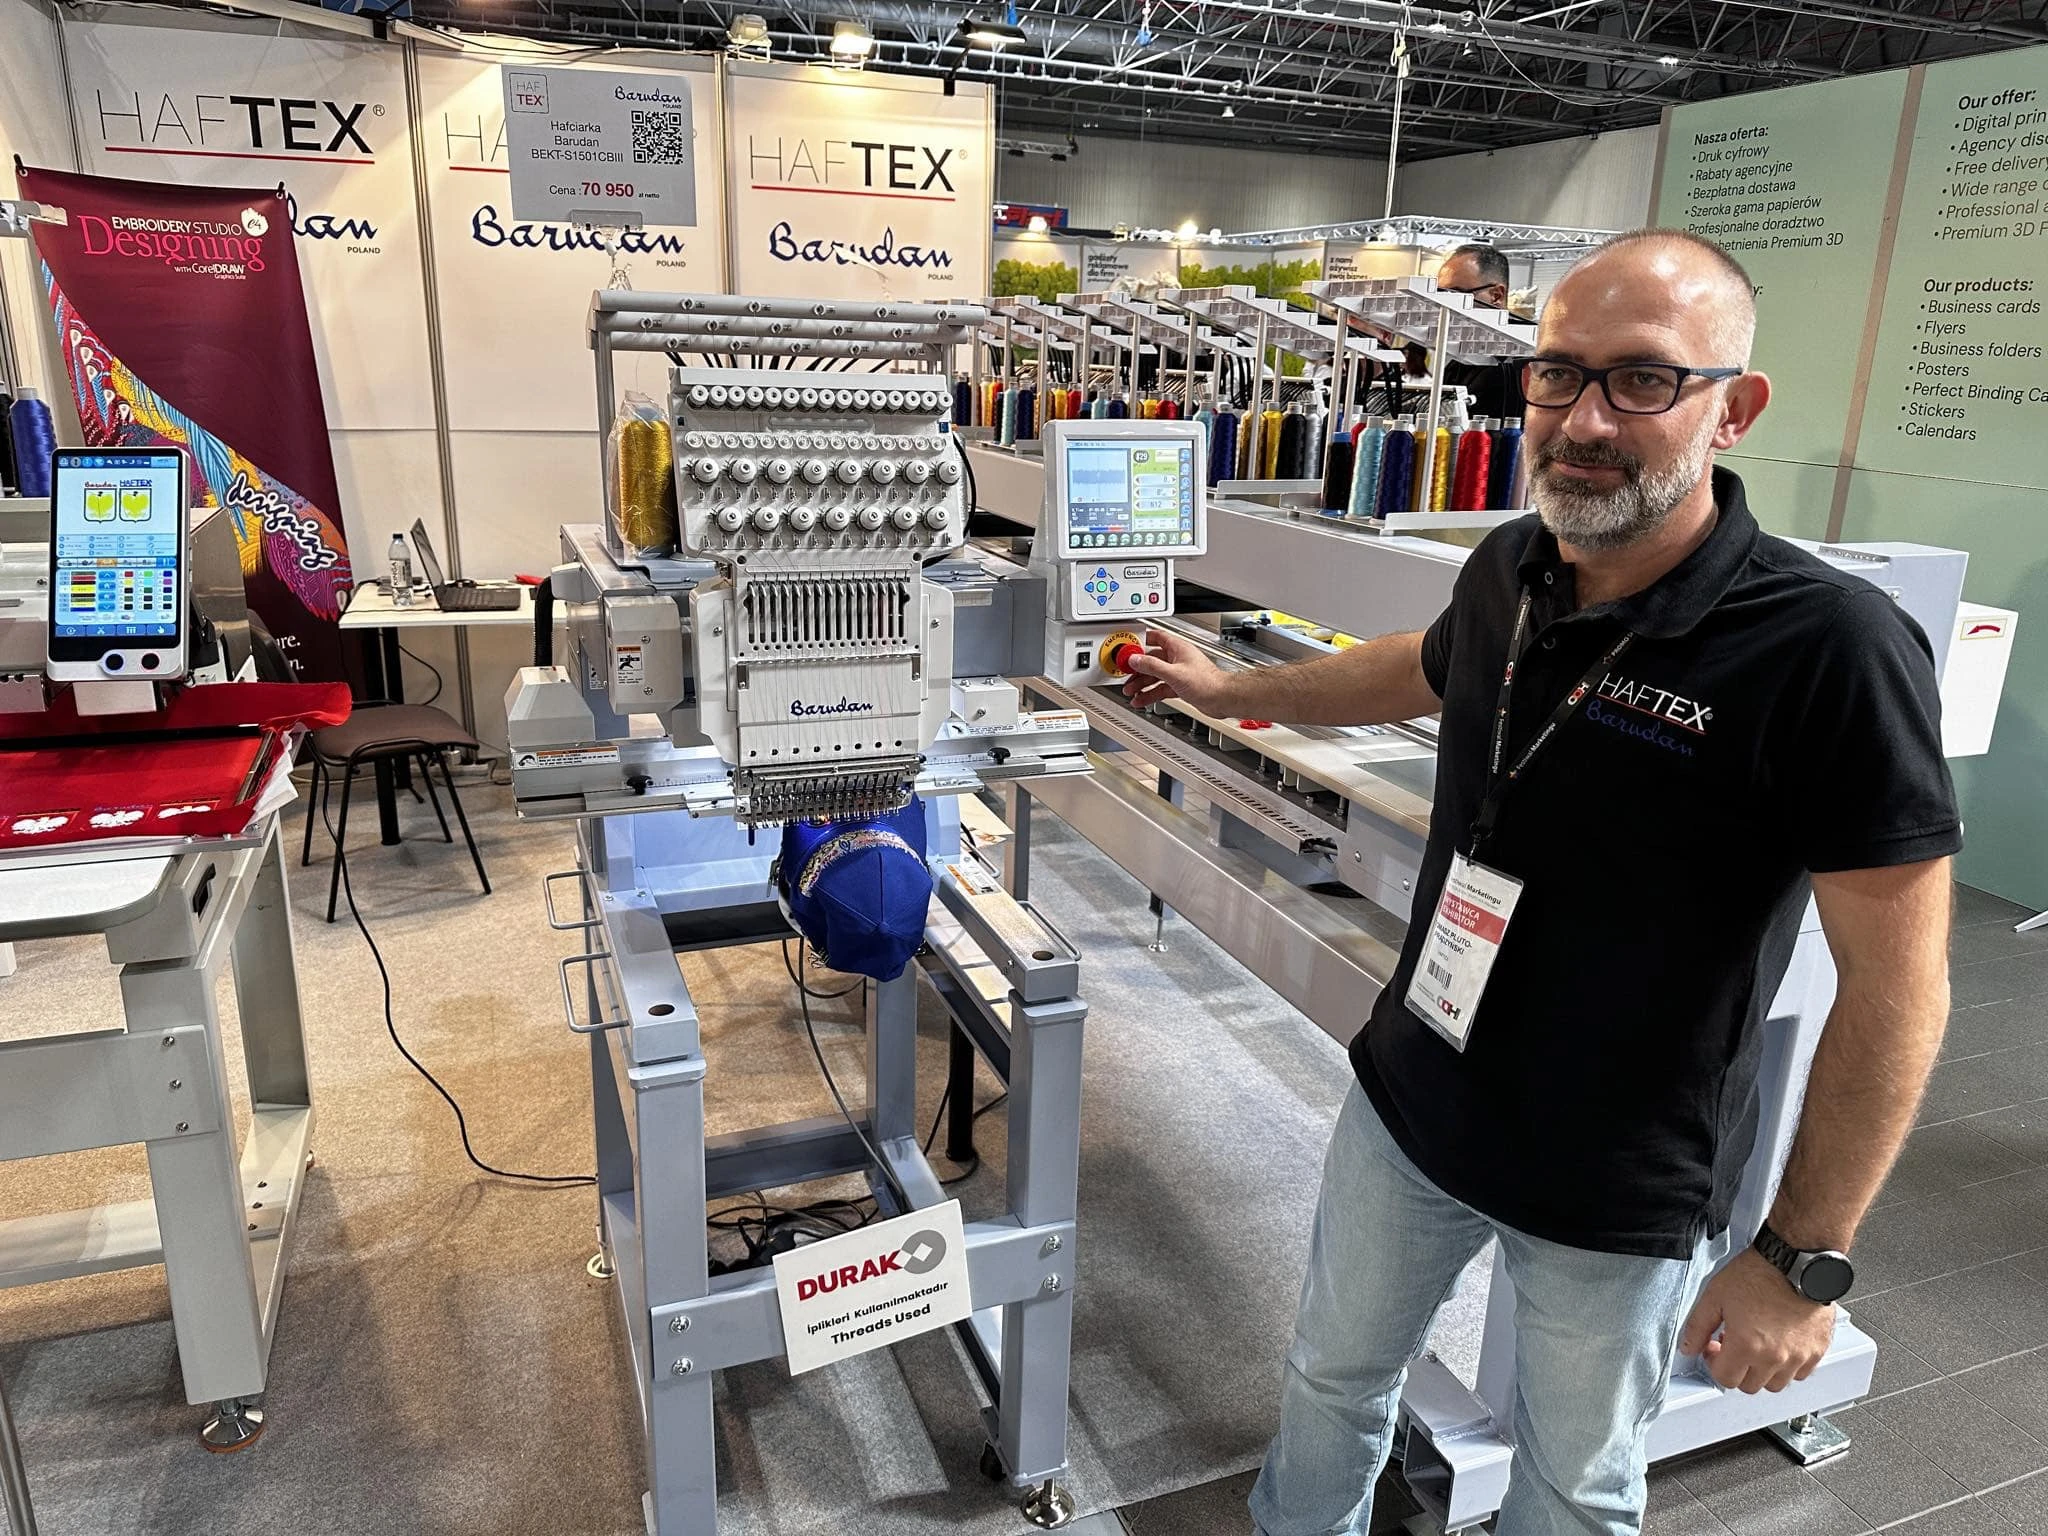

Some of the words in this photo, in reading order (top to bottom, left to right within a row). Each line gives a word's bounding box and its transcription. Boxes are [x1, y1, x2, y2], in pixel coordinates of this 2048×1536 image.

[516, 81, 541, 92] HAF
[614, 85, 682, 103] Barudan
[1958, 95, 1989, 110] Our
[1991, 89, 2037, 106] offer:
[551, 121, 601, 133] Hafciarka
[1963, 111, 2012, 134] Digital
[554, 135, 600, 148] Barudan
[1694, 133, 1727, 146] Nasza
[1729, 126, 1769, 142] oferta:
[1698, 149, 1722, 163] Druk
[1724, 145, 1770, 162] cyfrowy
[1958, 136, 2017, 157] Agency
[1695, 168, 1732, 182] Rabaty
[1735, 160, 1793, 180] agencyjne
[1954, 160, 1987, 176] Free
[549, 185, 576, 196] Cena
[605, 183, 634, 197] 950
[1693, 184, 1745, 201] Bezpłatna
[1747, 180, 1796, 195] dostawa
[1951, 181, 1989, 197] Wide
[1992, 179, 2038, 196] range
[1690, 203, 1731, 218] Szeroka
[1733, 202, 1764, 217] gama
[1766, 195, 1822, 214] papierów
[1946, 199, 2040, 219] Professional
[112, 216, 192, 233] EMBROIDERY
[194, 222, 242, 236] STUDIO
[1688, 219, 1759, 237] Profesjonalne
[1762, 216, 1825, 231] doradztwo
[1942, 224, 2008, 240] Premium
[2012, 222, 2035, 237] 3D
[77, 215, 266, 272] Designing
[1771, 234, 1823, 249] Premium
[1826, 232, 1844, 246] 3D
[347, 246, 381, 254] POLAND
[656, 260, 686, 268] POLAND
[928, 273, 954, 281] POLAND
[1924, 279, 1952, 293] Our
[1954, 277, 2034, 296] products:
[1928, 299, 1992, 314] Business
[1996, 299, 2041, 314] cards
[1924, 320, 1966, 337] Flyers
[1920, 341, 1984, 357] Business
[1988, 342, 2042, 358] folders
[1916, 361, 1970, 377] Posters
[1912, 381, 1964, 398] Perfect
[1967, 384, 2025, 405] Binding
[1908, 402, 1966, 418] Stickers
[1905, 422, 1977, 440] Calendars
[790, 695, 874, 716] Barudan
[1585, 699, 1695, 756] Barudan
[1466, 884, 1502, 905] Marketingu
[797, 1249, 905, 1301] DURAK
[831, 1317, 893, 1345] Threads
[895, 1303, 931, 1324] Used
